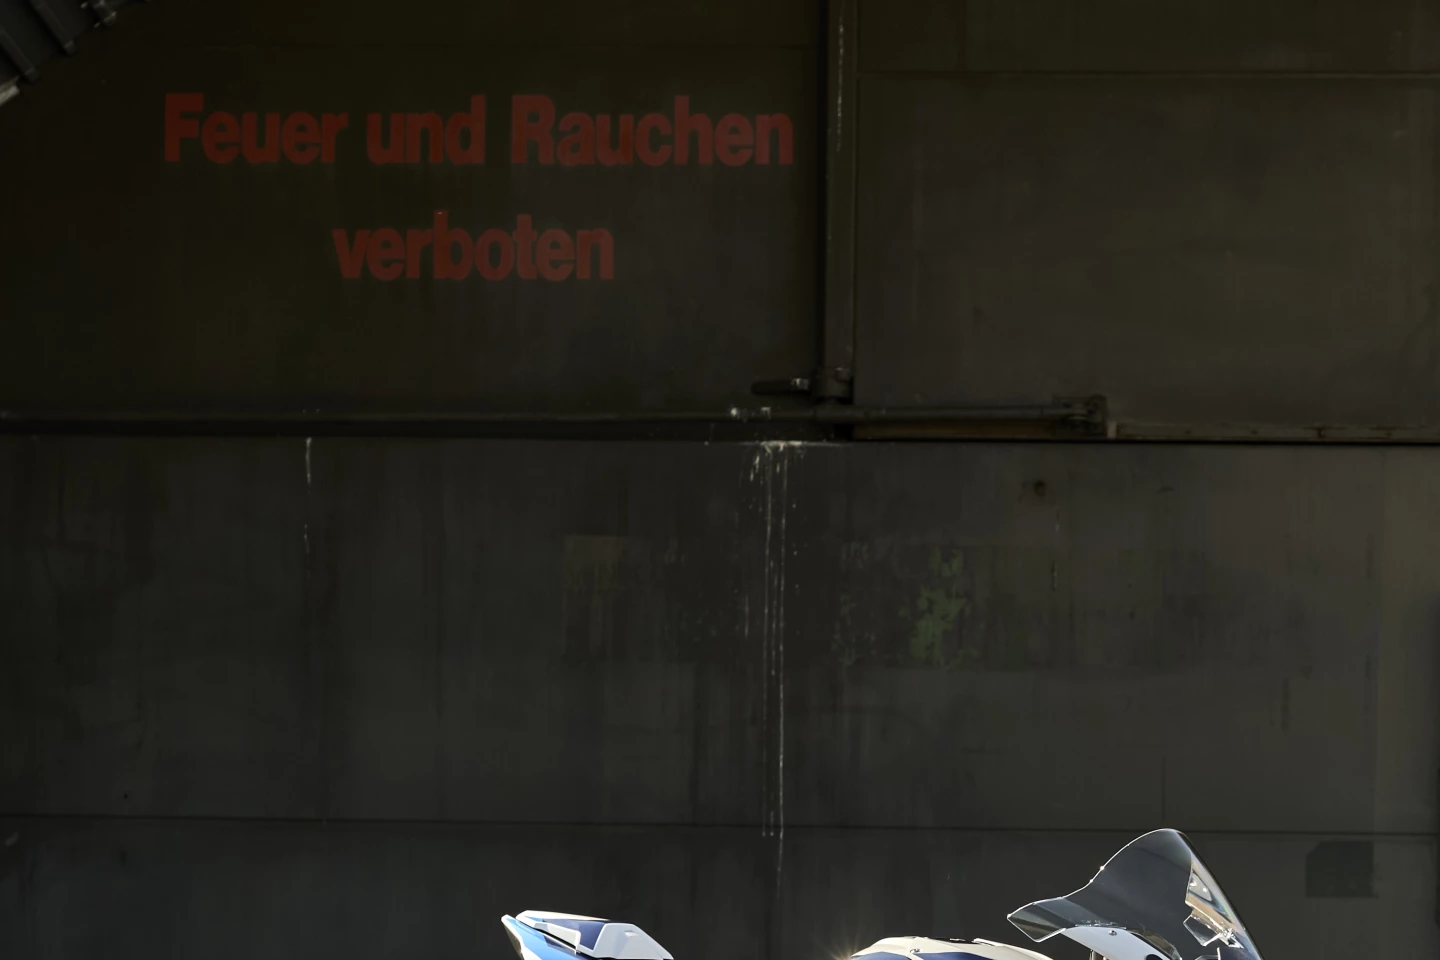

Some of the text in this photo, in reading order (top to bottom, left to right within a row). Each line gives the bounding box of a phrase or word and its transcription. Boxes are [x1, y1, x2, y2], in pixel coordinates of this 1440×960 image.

[164, 93, 793, 166] Feuer und Rauchen
[332, 210, 614, 281] verboten
